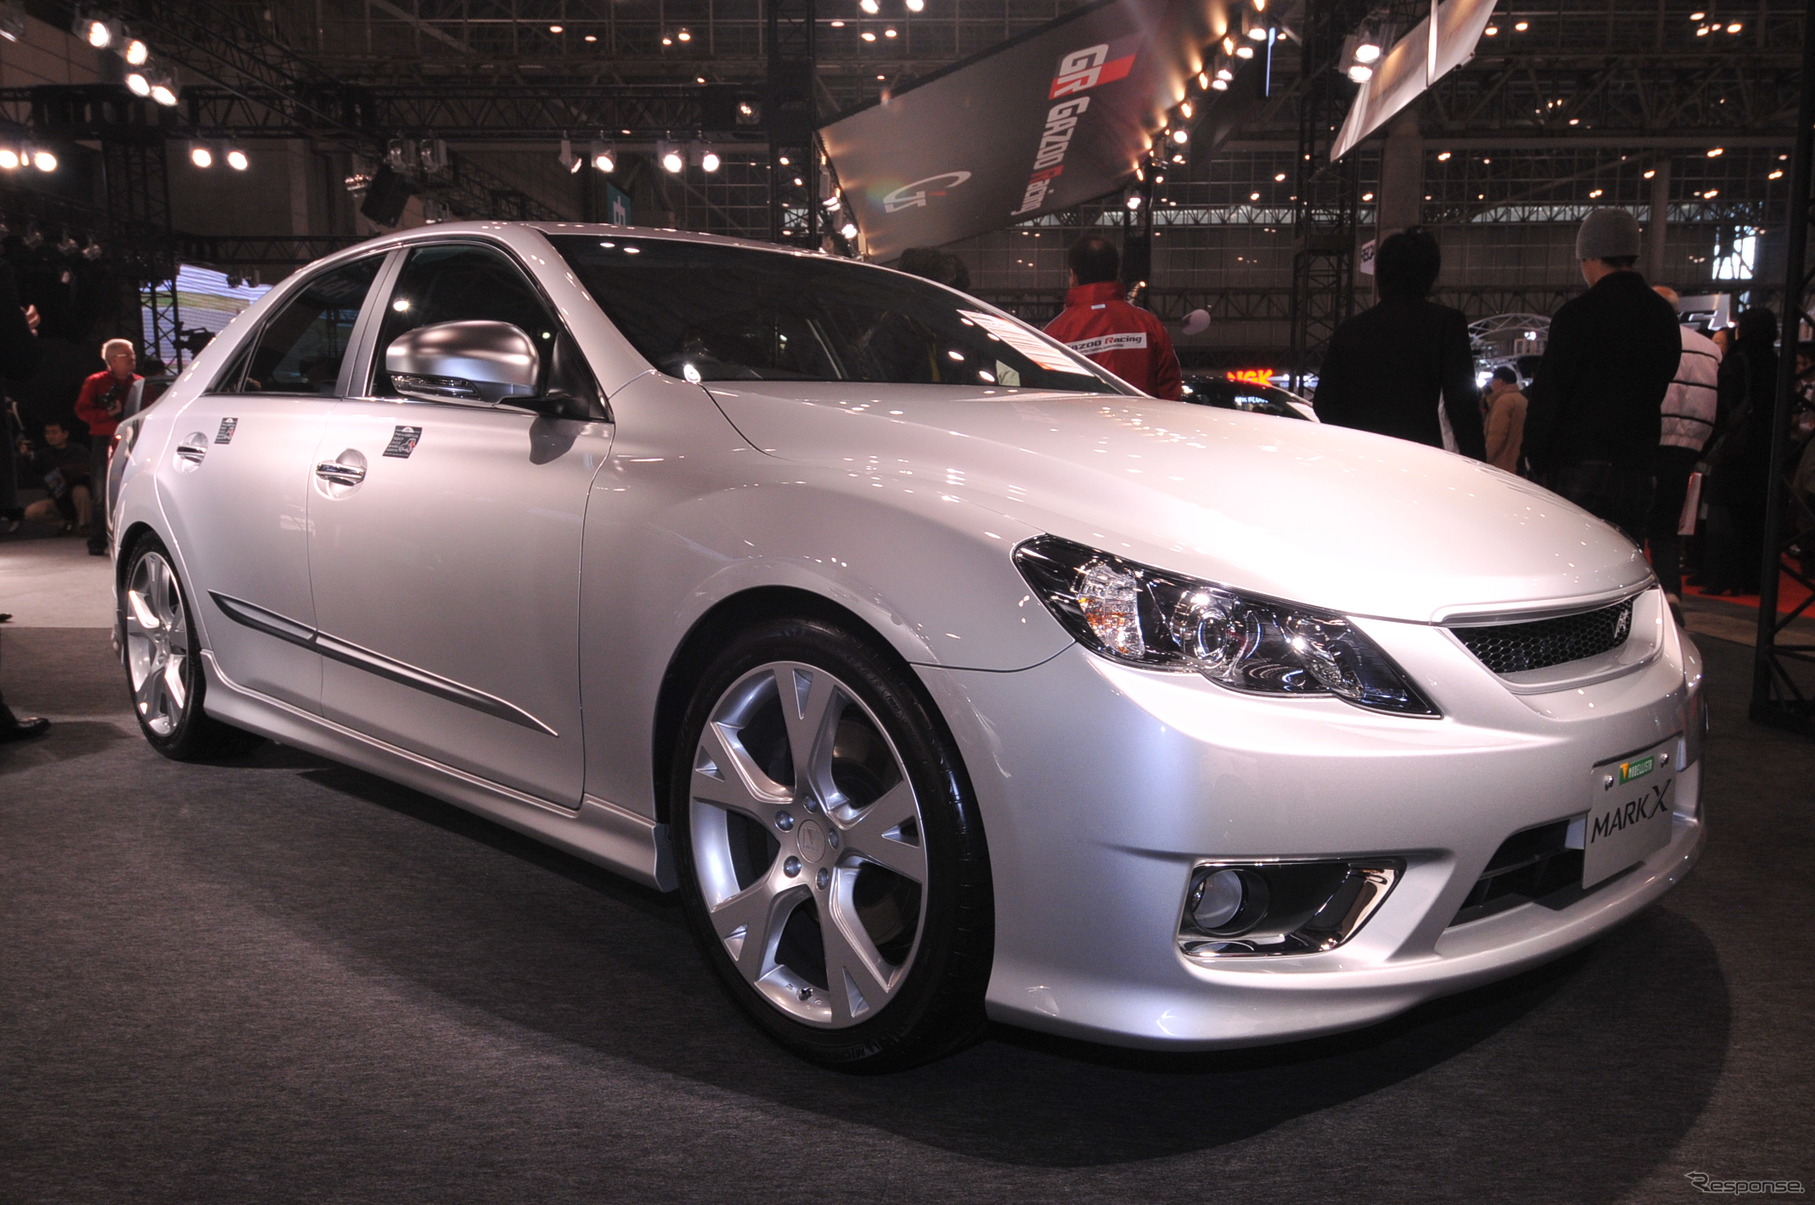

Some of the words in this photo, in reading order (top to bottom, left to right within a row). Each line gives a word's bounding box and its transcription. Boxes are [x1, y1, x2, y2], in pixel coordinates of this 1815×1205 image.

[1054, 43, 1109, 98] GR
[1033, 96, 1091, 170] GAZOO
[1011, 164, 1064, 216] Racing
[1105, 335, 1142, 345] Racing
[1591, 794, 1650, 844] MARK
[1647, 778, 1673, 820] X
